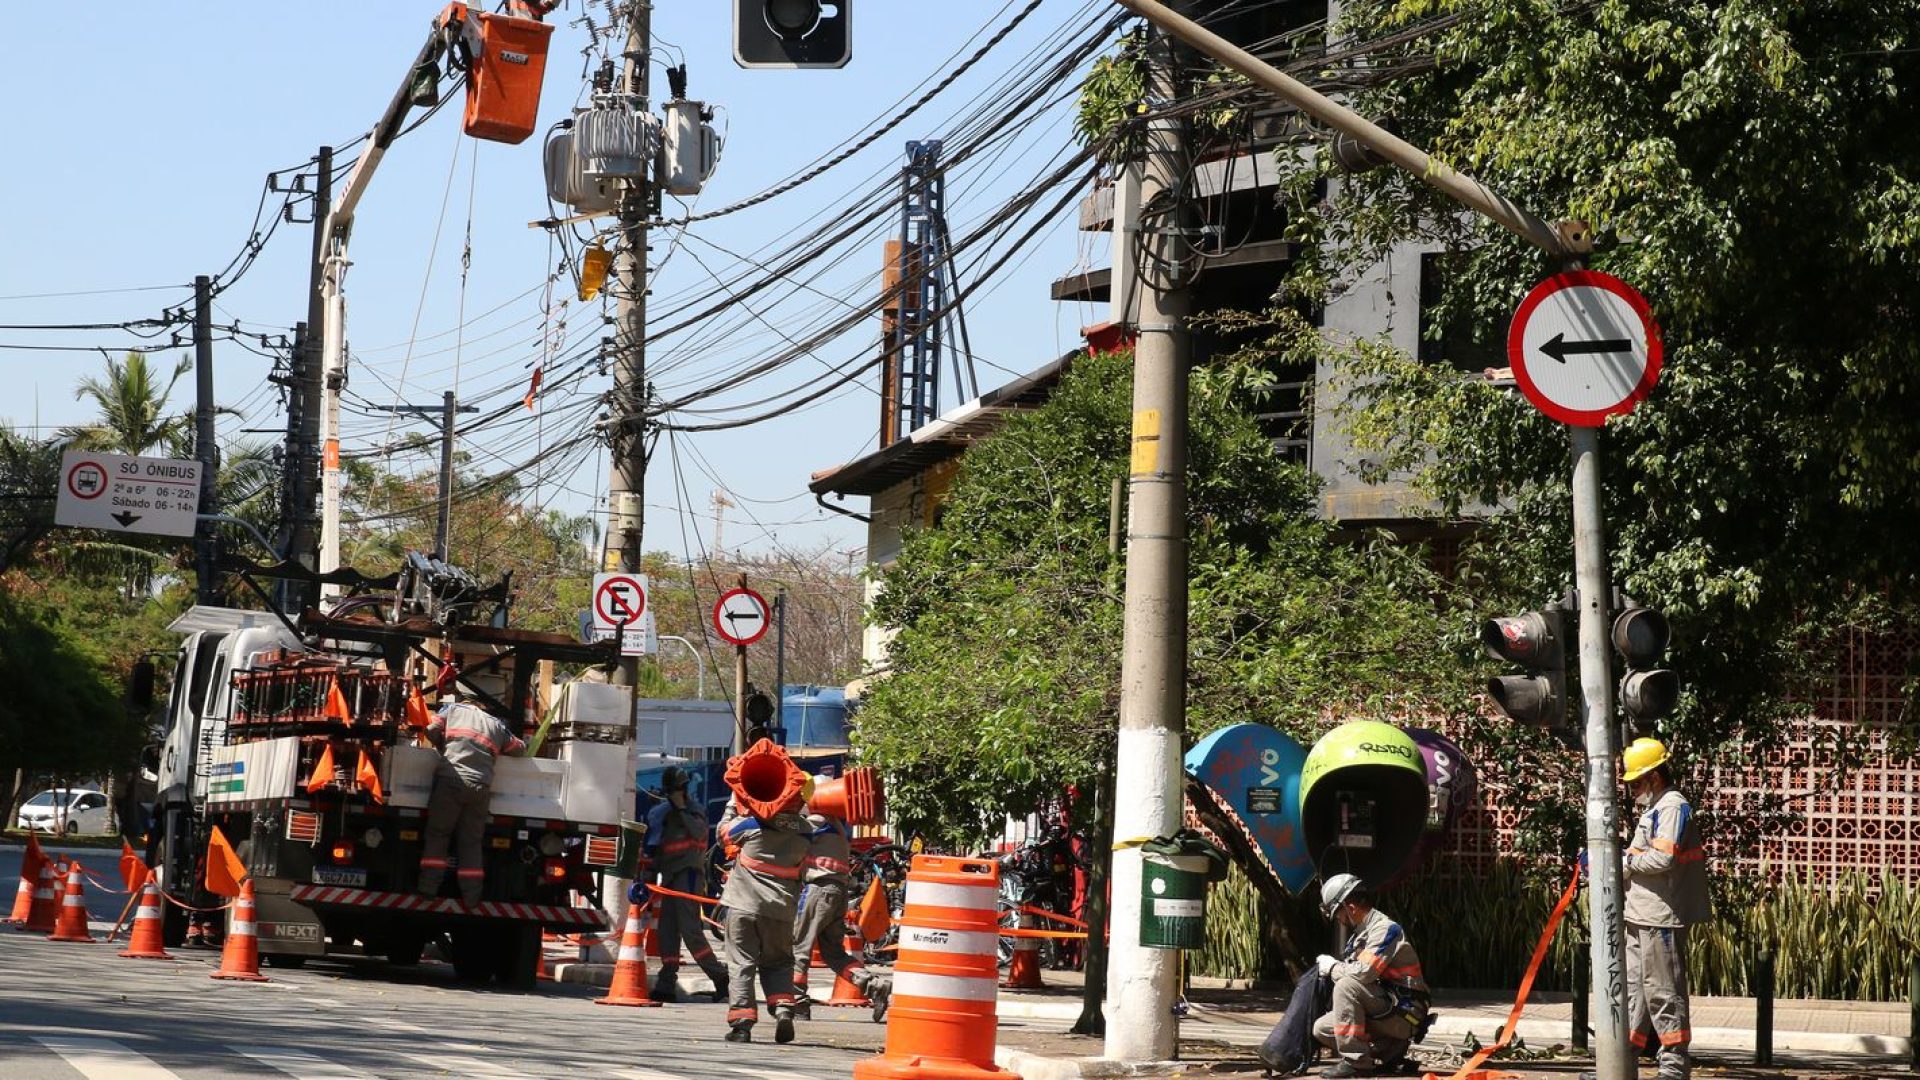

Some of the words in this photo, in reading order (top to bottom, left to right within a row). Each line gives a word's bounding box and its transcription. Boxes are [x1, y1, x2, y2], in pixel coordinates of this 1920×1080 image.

[120, 460, 139, 475] SÓ
[146, 462, 196, 479] ÔNIBUS
[611, 586, 630, 615] E
[275, 924, 317, 938] NEXT
